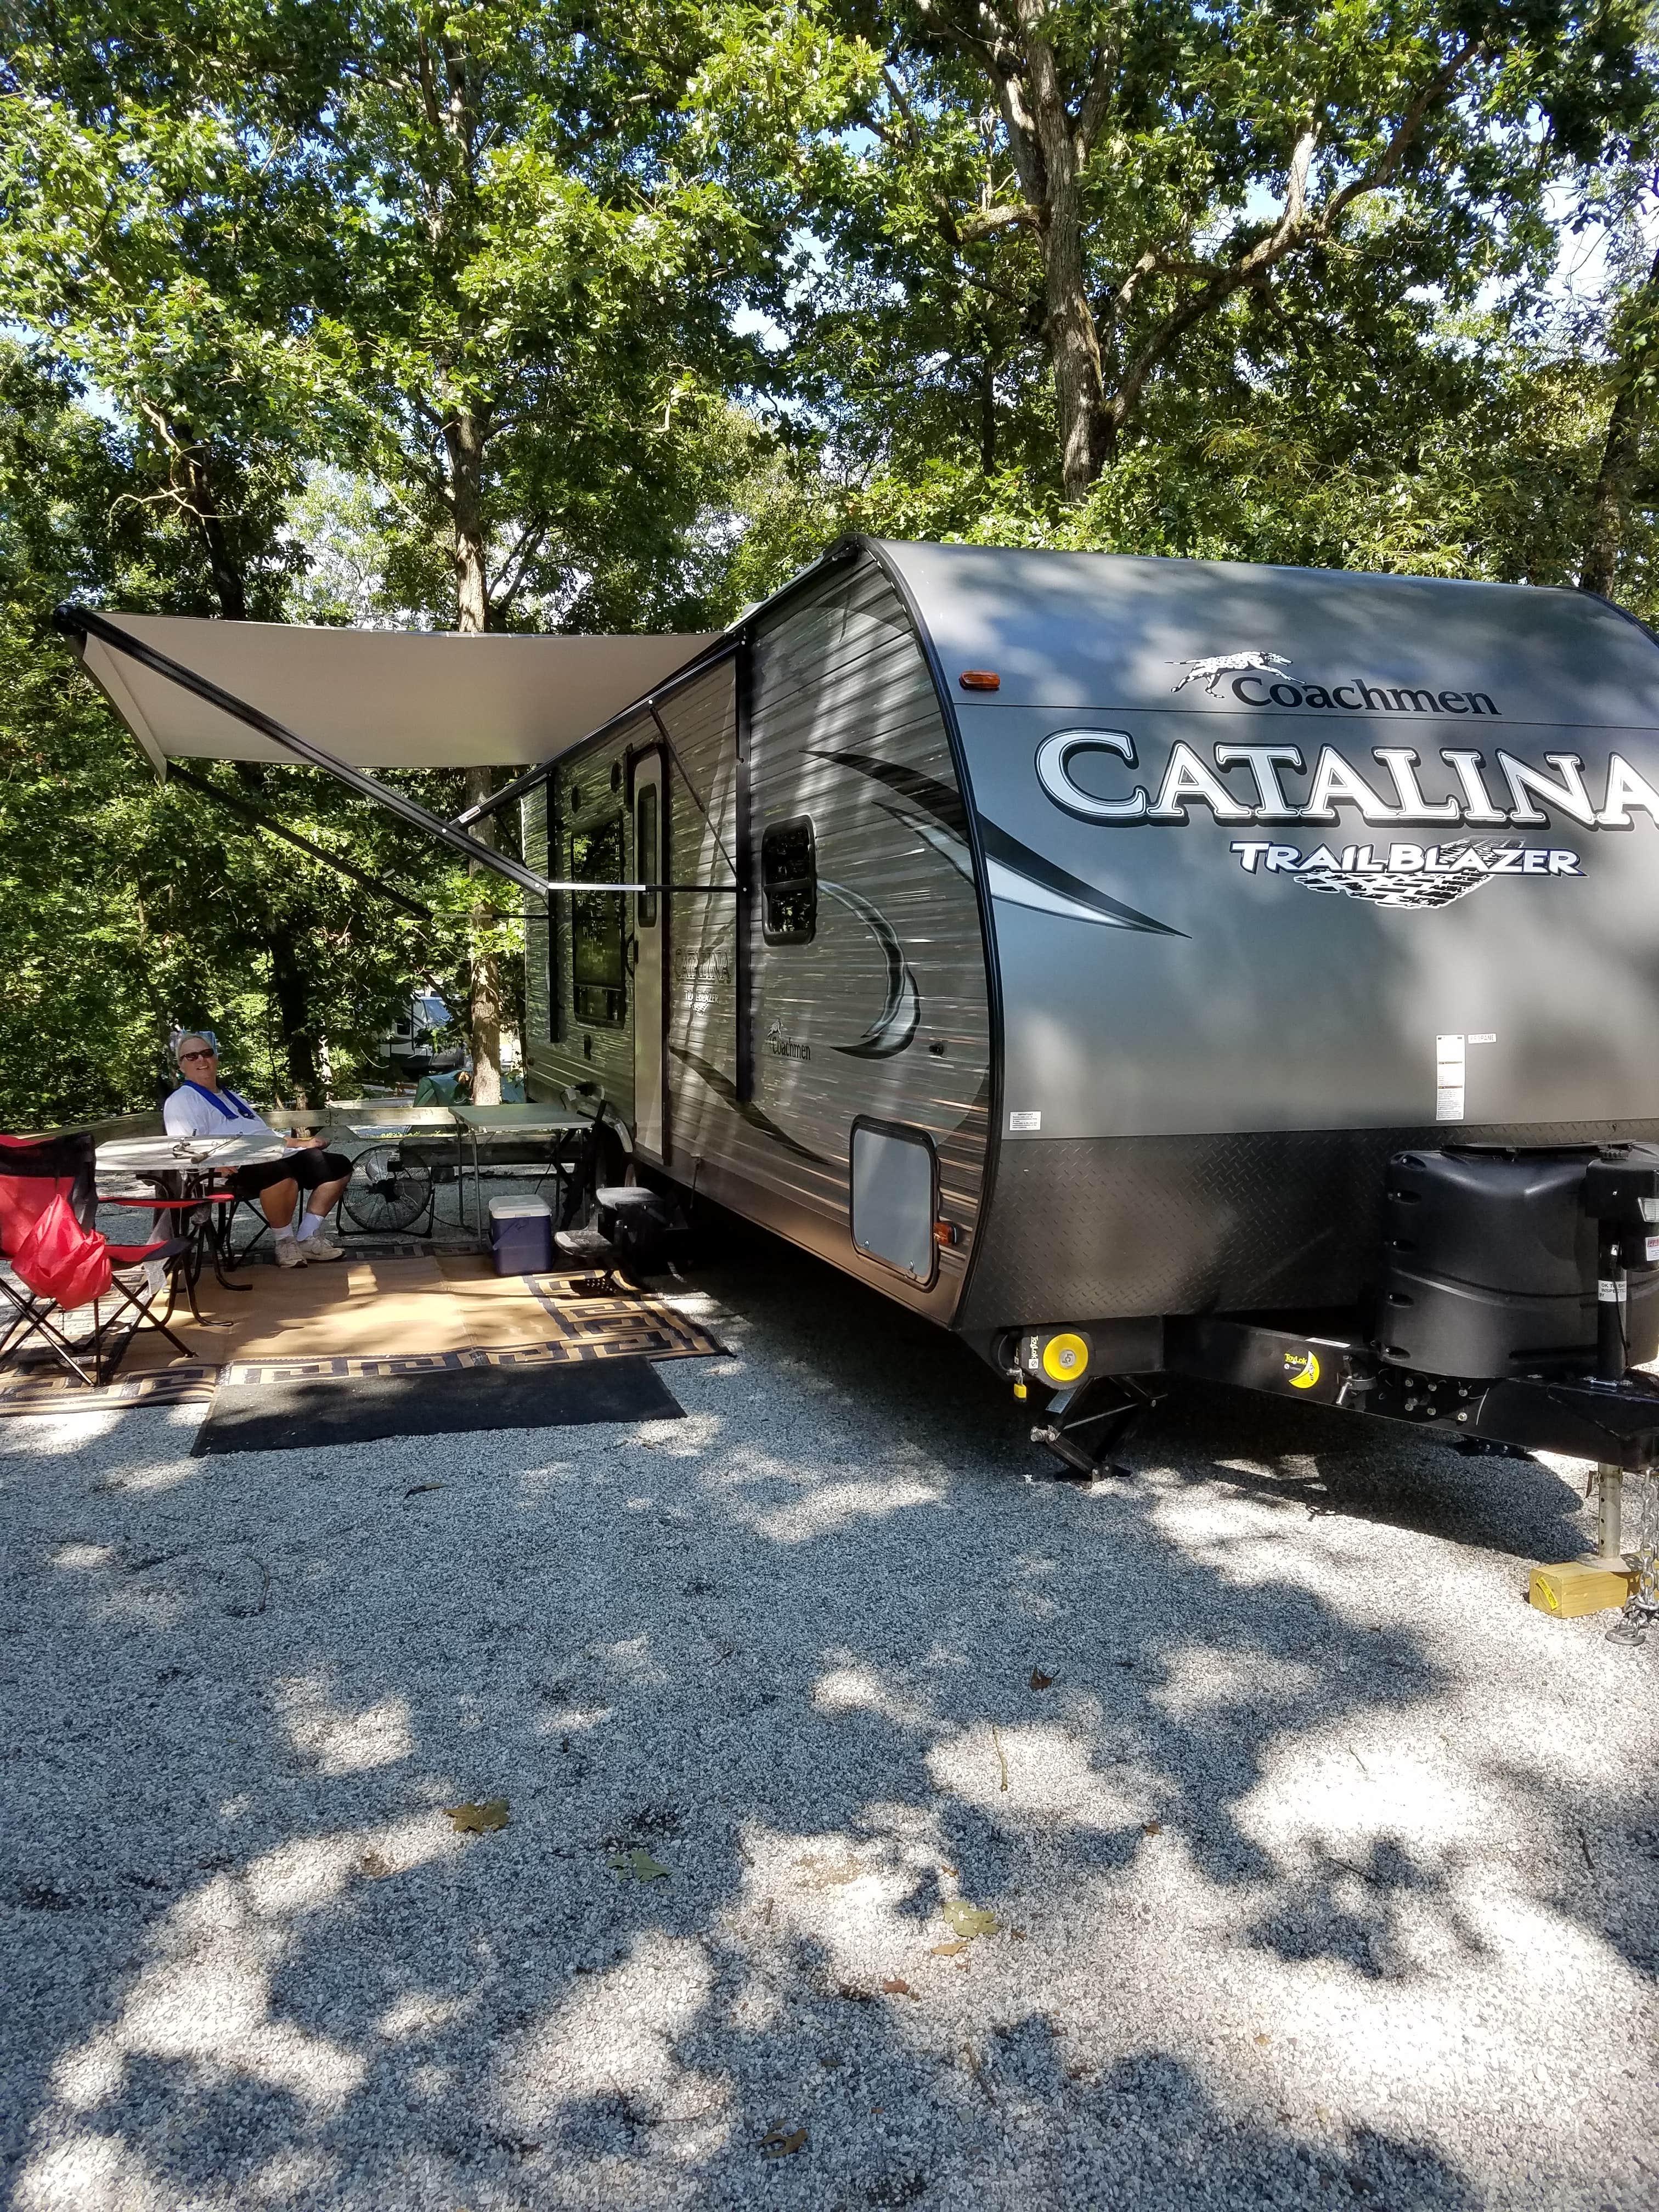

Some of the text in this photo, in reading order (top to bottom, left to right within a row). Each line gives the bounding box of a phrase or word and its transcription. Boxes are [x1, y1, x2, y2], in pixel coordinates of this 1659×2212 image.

[1232, 678, 1502, 715] Coachmen
[1035, 727, 1659, 832] CATALINA
[772, 1037, 811, 1060] Coachmen
